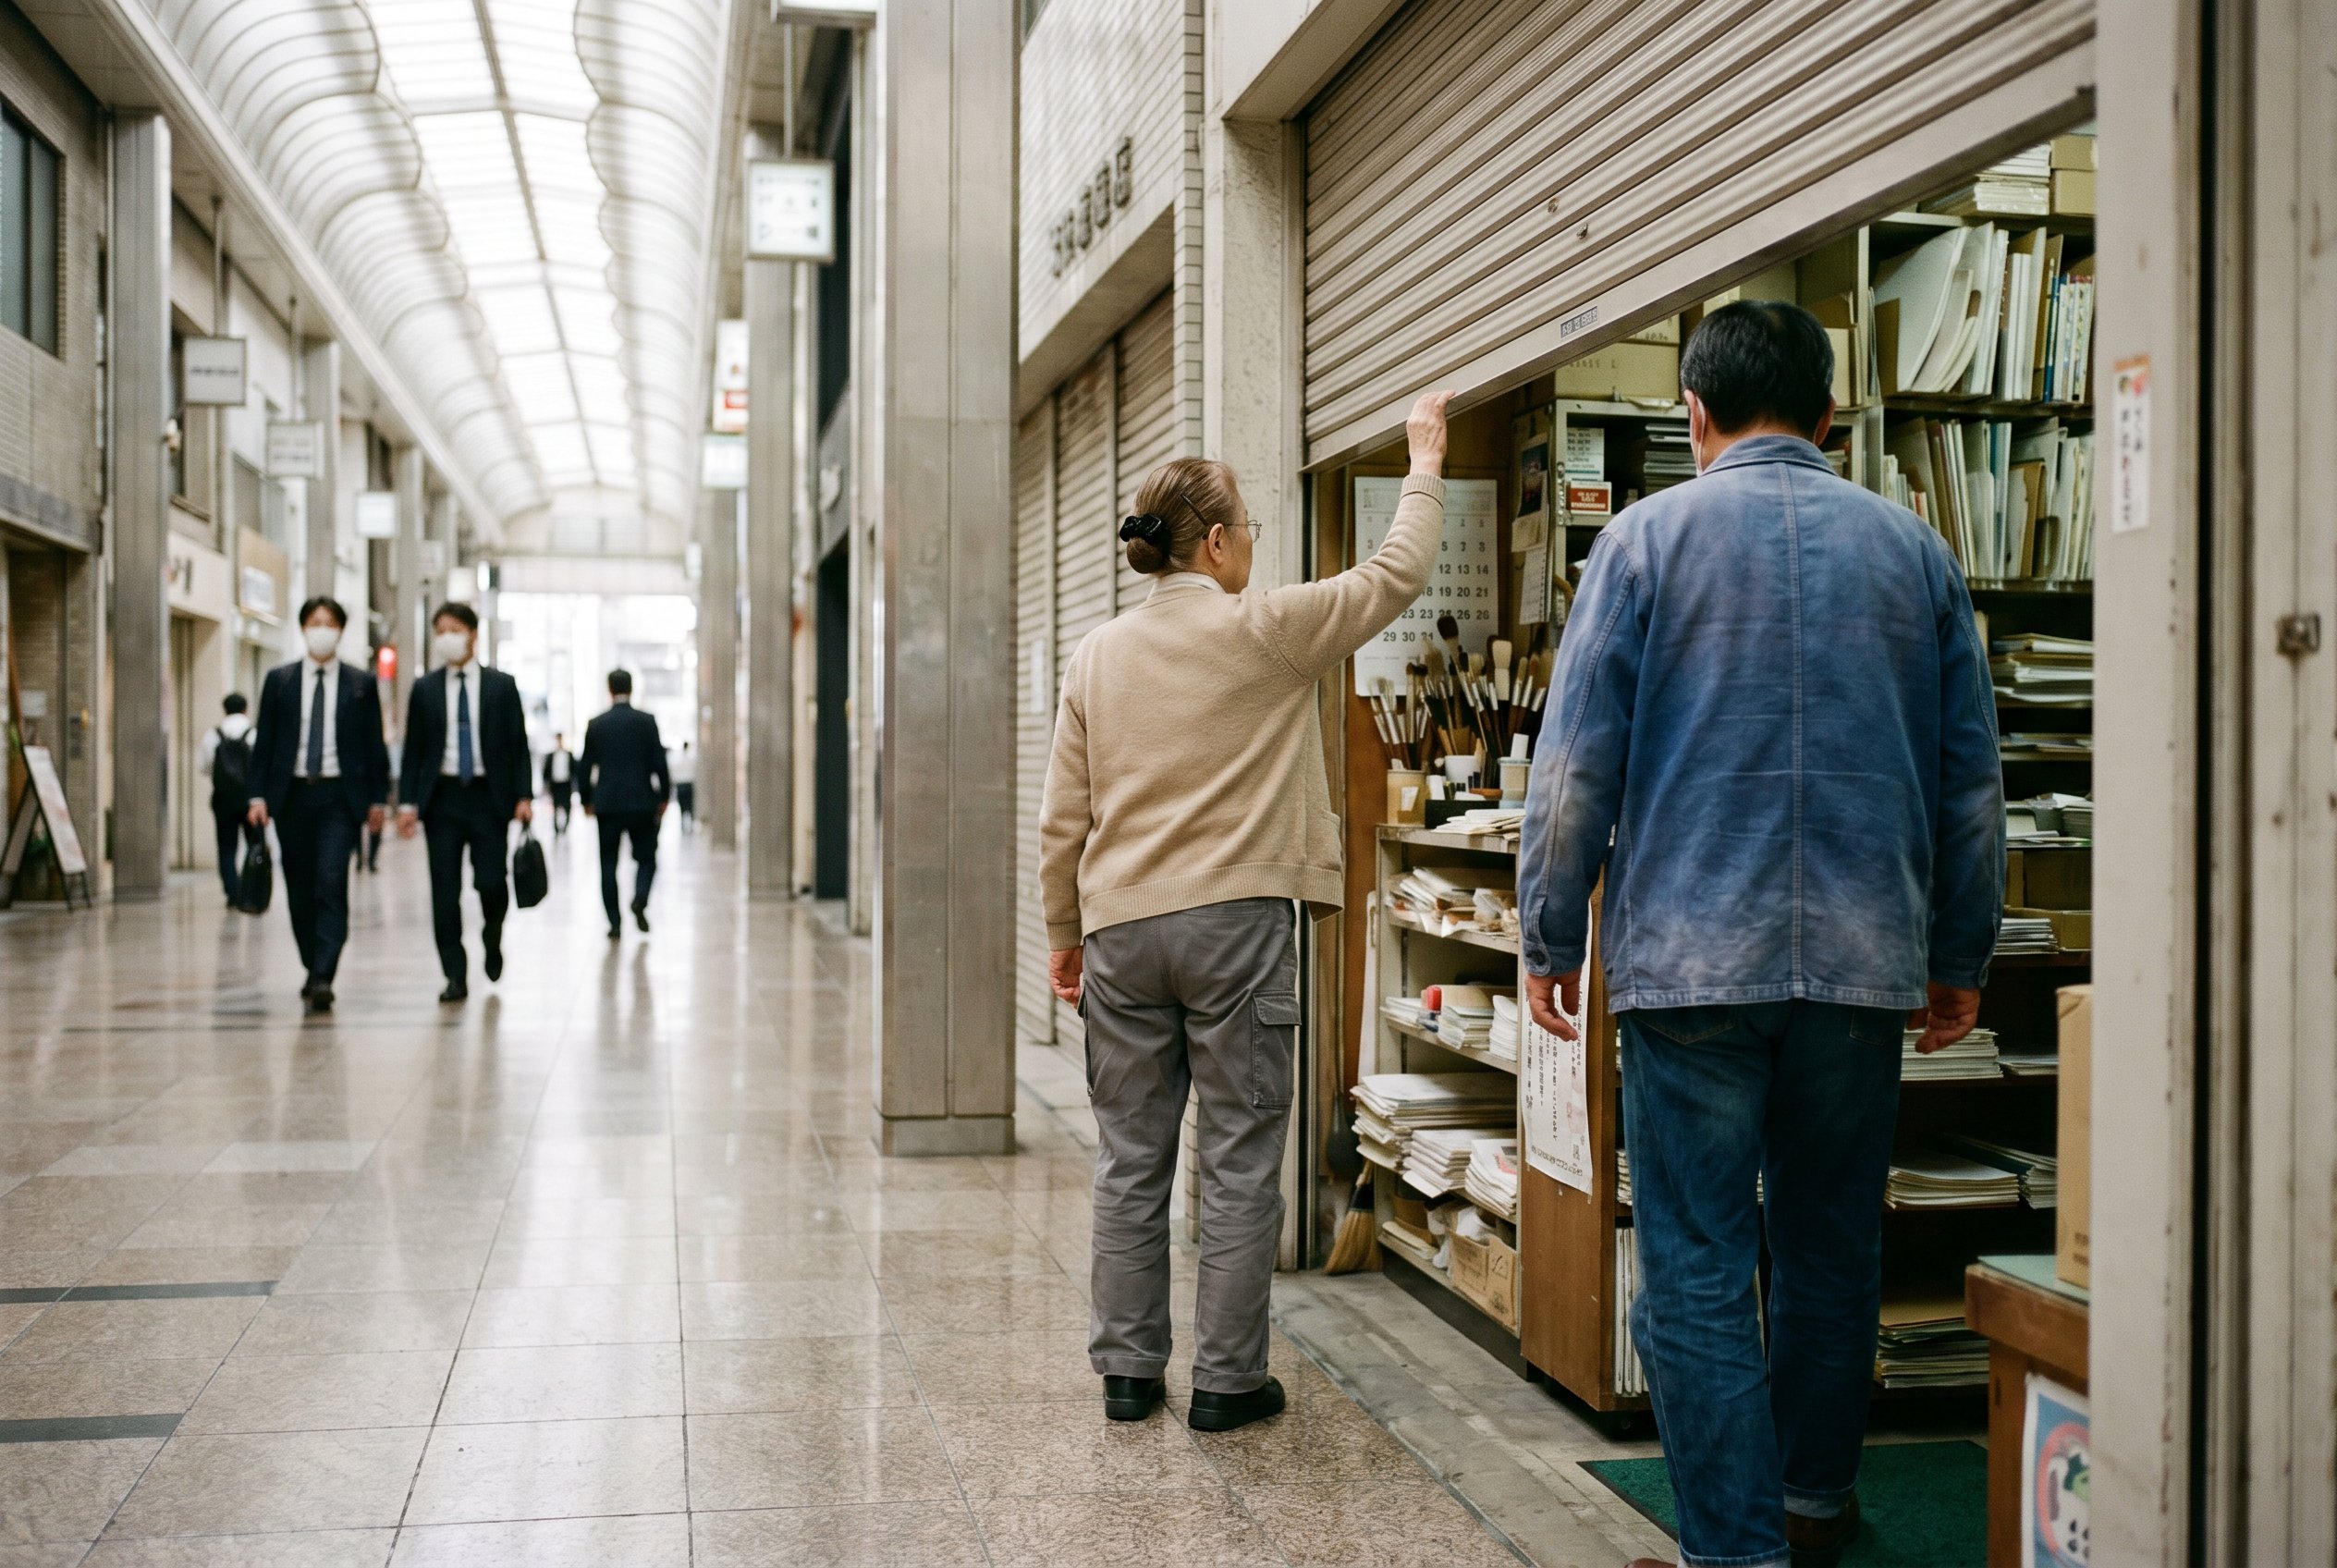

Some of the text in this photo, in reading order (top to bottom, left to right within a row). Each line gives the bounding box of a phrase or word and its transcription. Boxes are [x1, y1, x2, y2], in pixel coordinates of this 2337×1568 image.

[1438, 563, 1451, 574] 12
[1457, 564, 1470, 574] 13
[1438, 586, 1451, 596] 19
[1457, 586, 1470, 597] 20
[1401, 608, 1414, 619] 23
[1420, 608, 1433, 619] 23
[1457, 609, 1471, 620] 26
[1383, 631, 1397, 642] 29
[1401, 631, 1415, 642] 30
